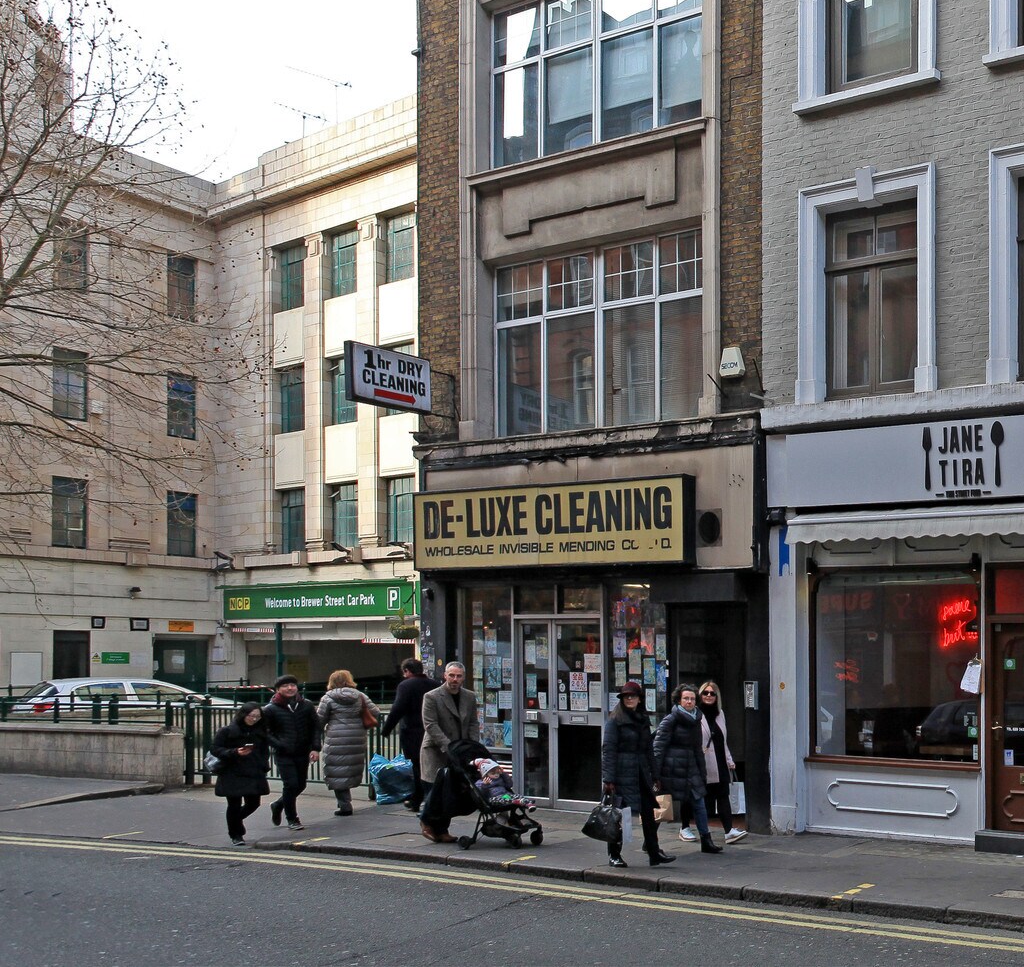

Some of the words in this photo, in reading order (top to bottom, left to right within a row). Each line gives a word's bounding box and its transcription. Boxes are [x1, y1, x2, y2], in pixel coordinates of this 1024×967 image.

[398, 359, 423, 378] DRY
[721, 362, 739, 370] SECOM
[362, 369, 426, 397] CLEANING
[938, 424, 983, 454] JANE
[938, 457, 985, 487] TIRA
[423, 494, 528, 540] DE-LUXE
[534, 485, 673, 535] CLEANING
[425, 544, 494, 557] WHOLESALE
[499, 542, 554, 554] INVISIBLE
[559, 540, 615, 553] MENDING
[230, 597, 250, 610] NCP
[265, 597, 292, 608] Welcome
[293, 597, 300, 608] to
[301, 595, 323, 607] Brewer
[324, 594, 345, 606] Street
[347, 594, 358, 605] Car
[359, 593, 375, 605] Park
[389, 590, 398, 607] P
